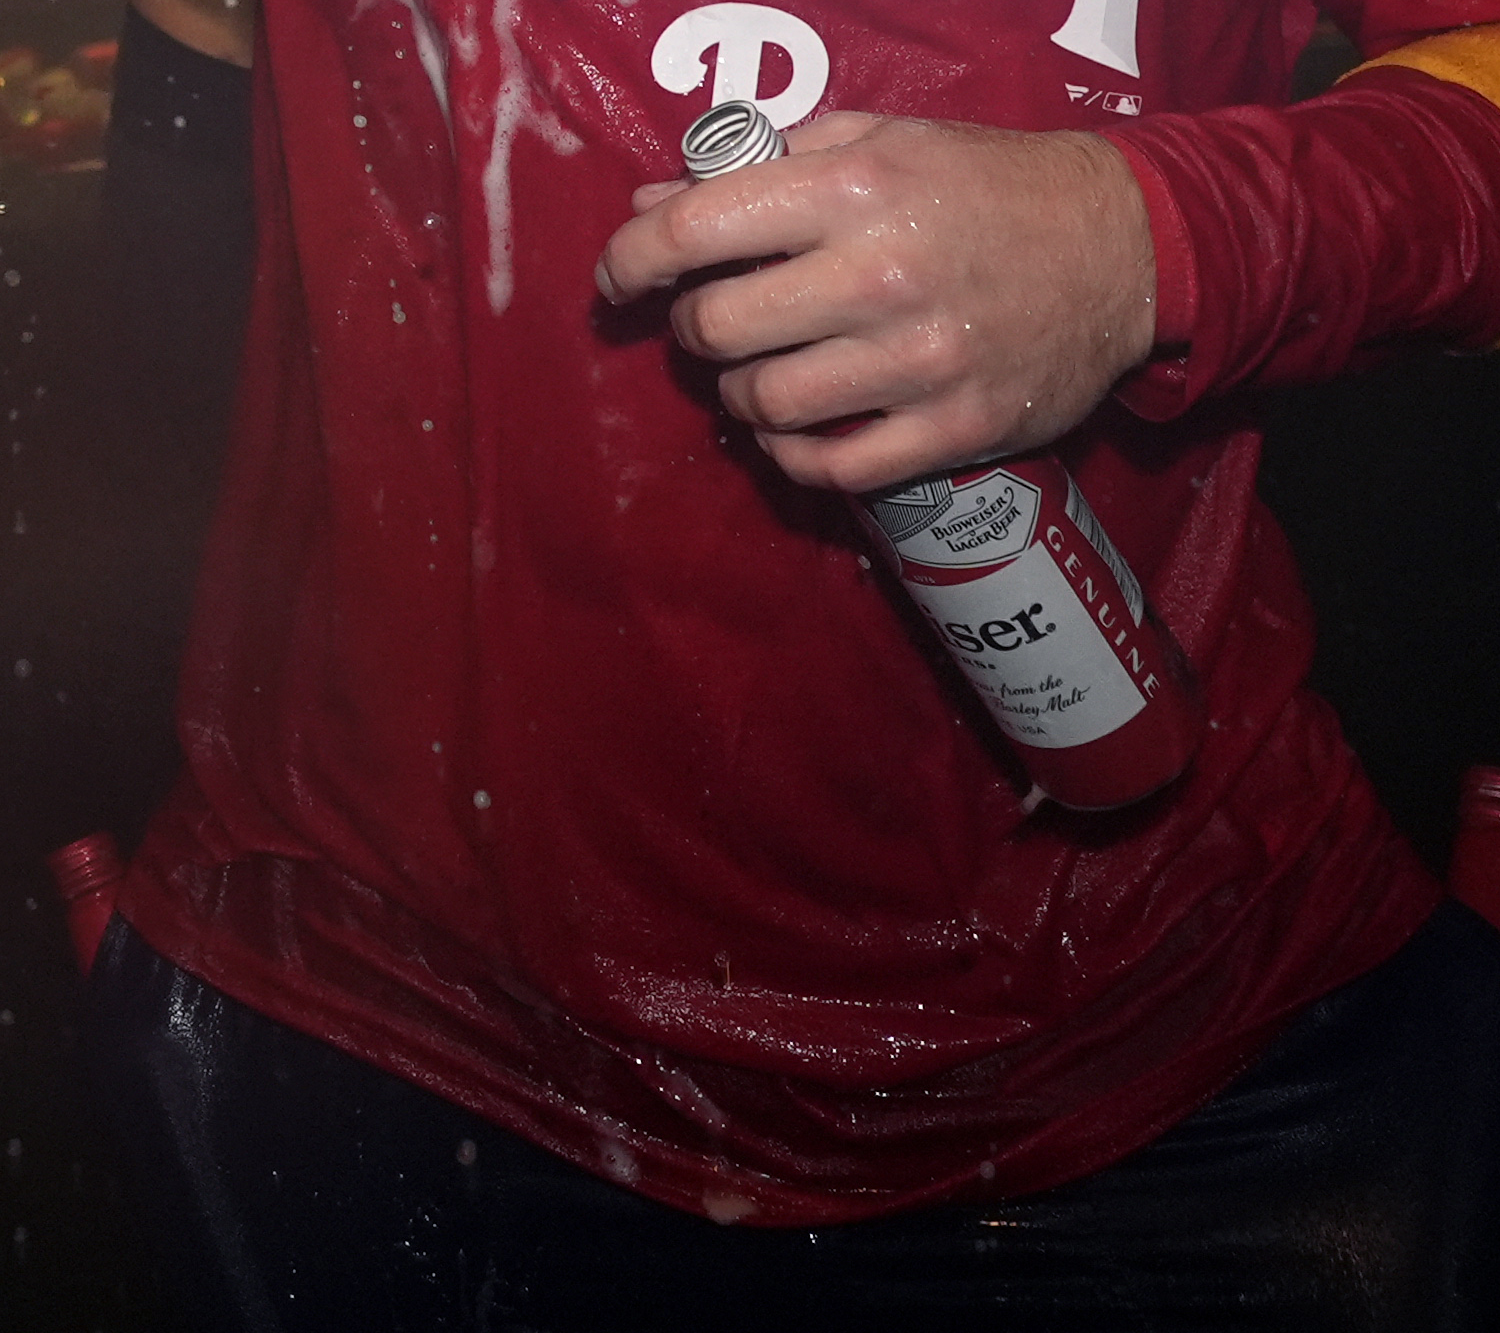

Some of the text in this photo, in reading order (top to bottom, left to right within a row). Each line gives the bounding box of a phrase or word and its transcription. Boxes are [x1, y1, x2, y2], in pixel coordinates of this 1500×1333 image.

[929, 493, 1010, 542] BUDWEISER
[945, 504, 1023, 554] LAGER BEER
[1044, 524, 1162, 702] GENUINE
[999, 682, 1037, 699] from
[1039, 674, 1064, 694] the
[1040, 686, 1091, 713] Malt
